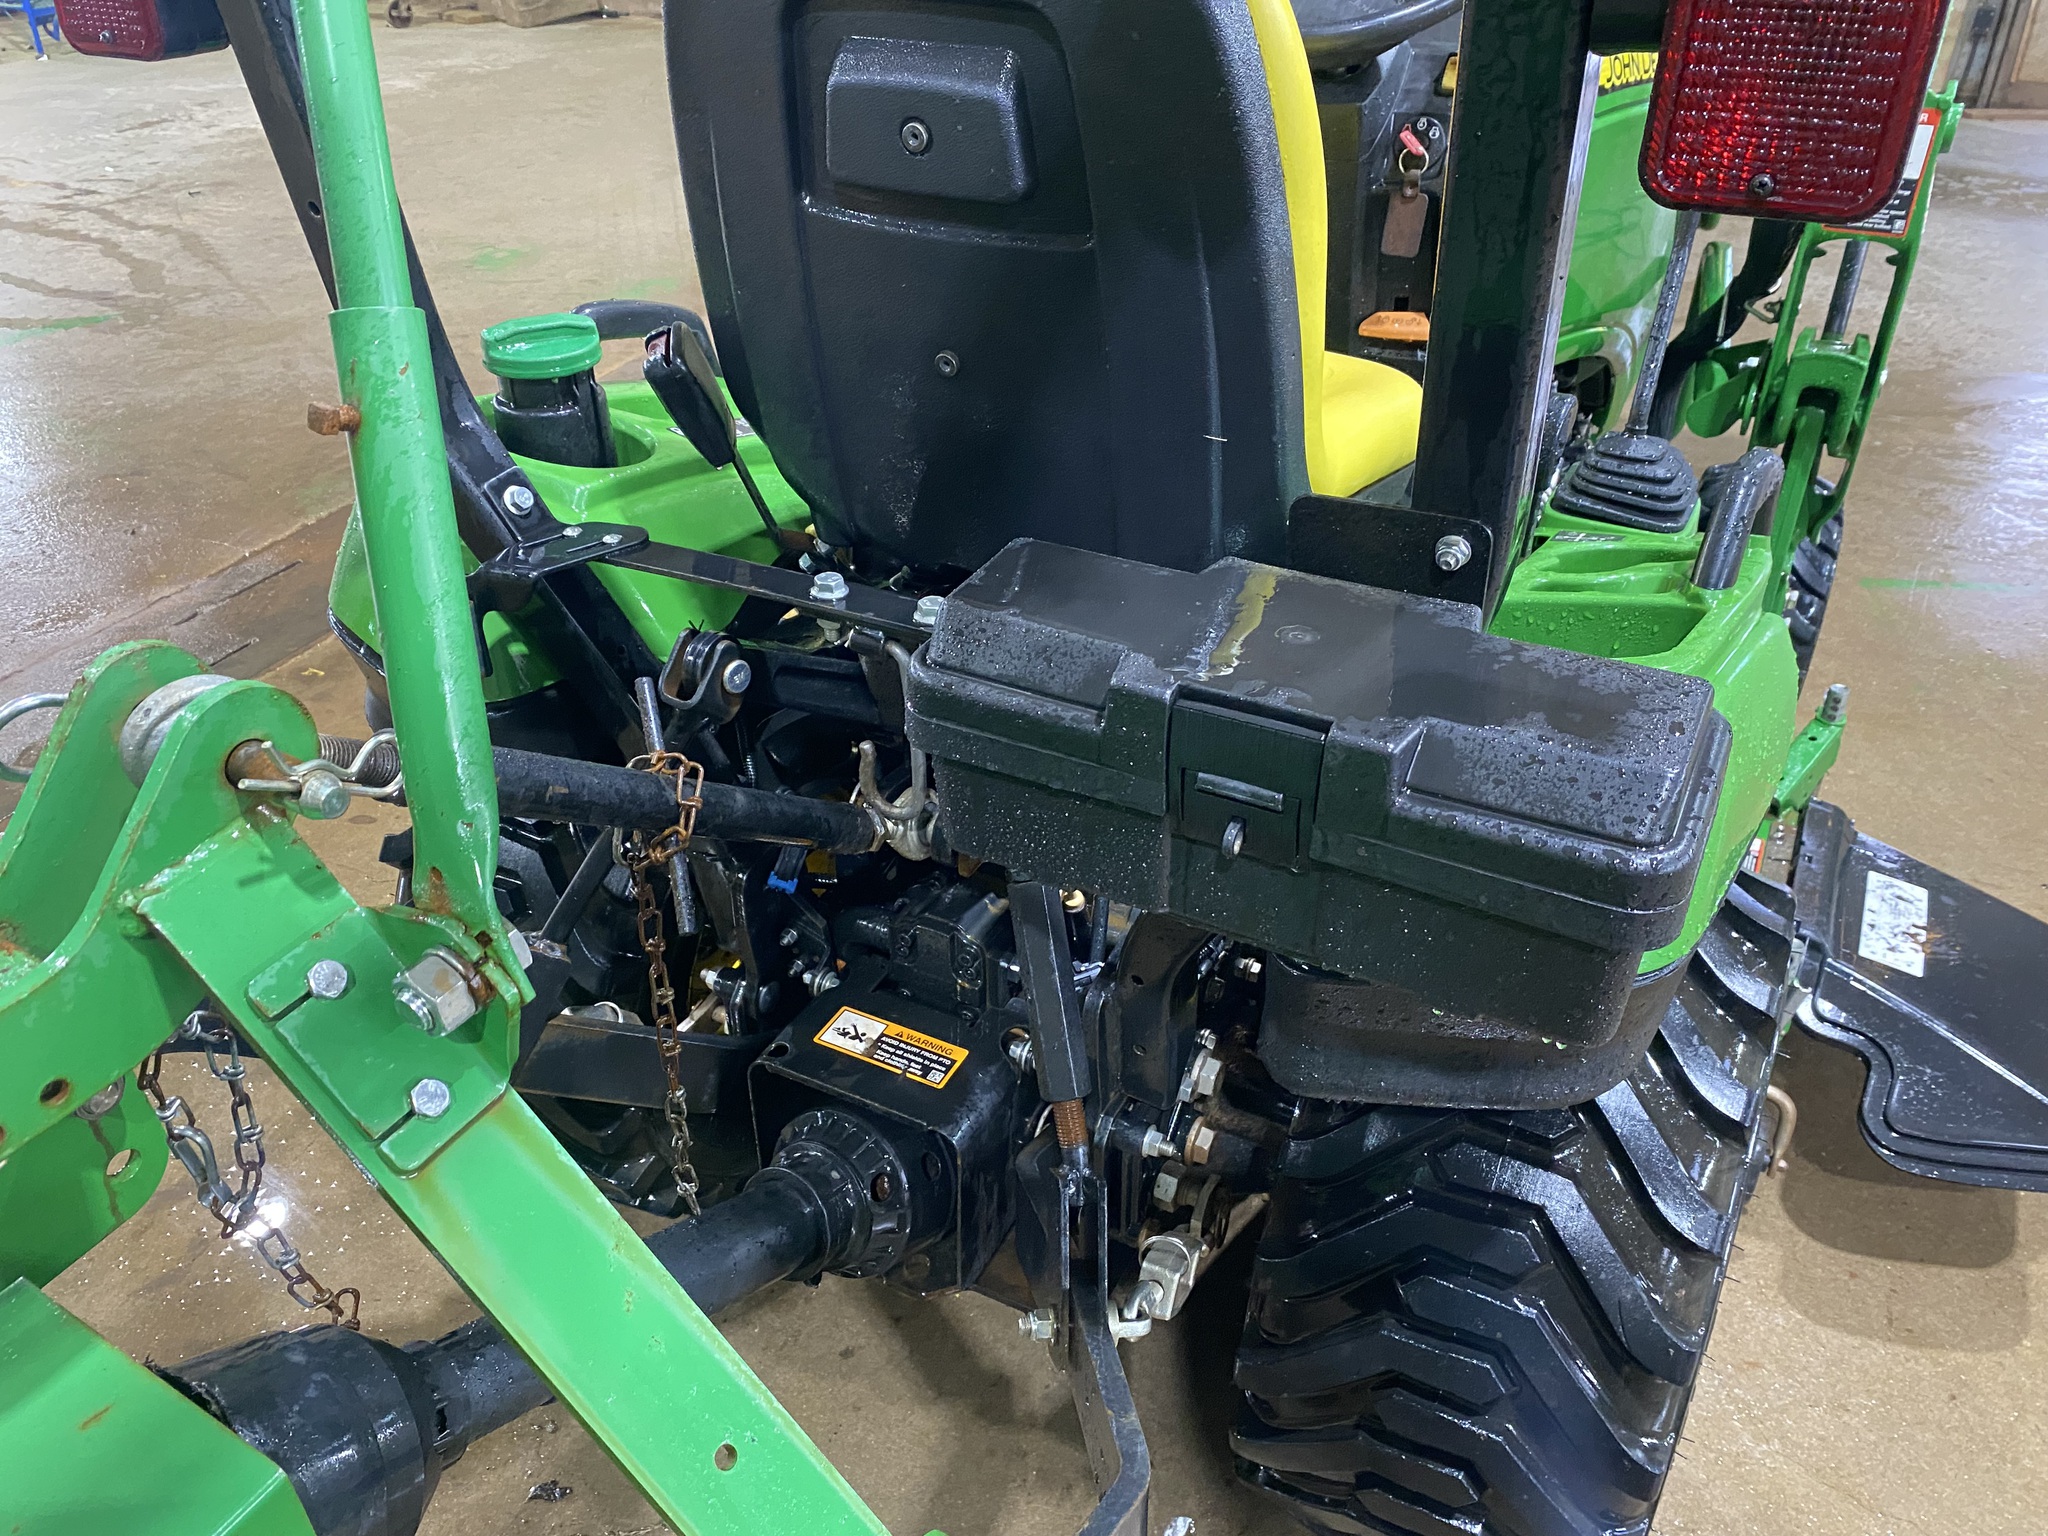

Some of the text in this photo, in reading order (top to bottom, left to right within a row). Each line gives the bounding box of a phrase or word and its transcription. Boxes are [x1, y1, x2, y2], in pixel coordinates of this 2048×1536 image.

[1606, 53, 1642, 83] JOHN
[881, 1036, 951, 1065] AVOID INJURY FROM PTO
[881, 1044, 896, 1053] Keep
[903, 1052, 923, 1063] shields
[930, 1062, 946, 1071] place
[906, 1033, 953, 1056] WARNING
[876, 1049, 891, 1058] Keep
[910, 1061, 922, 1069] feet
